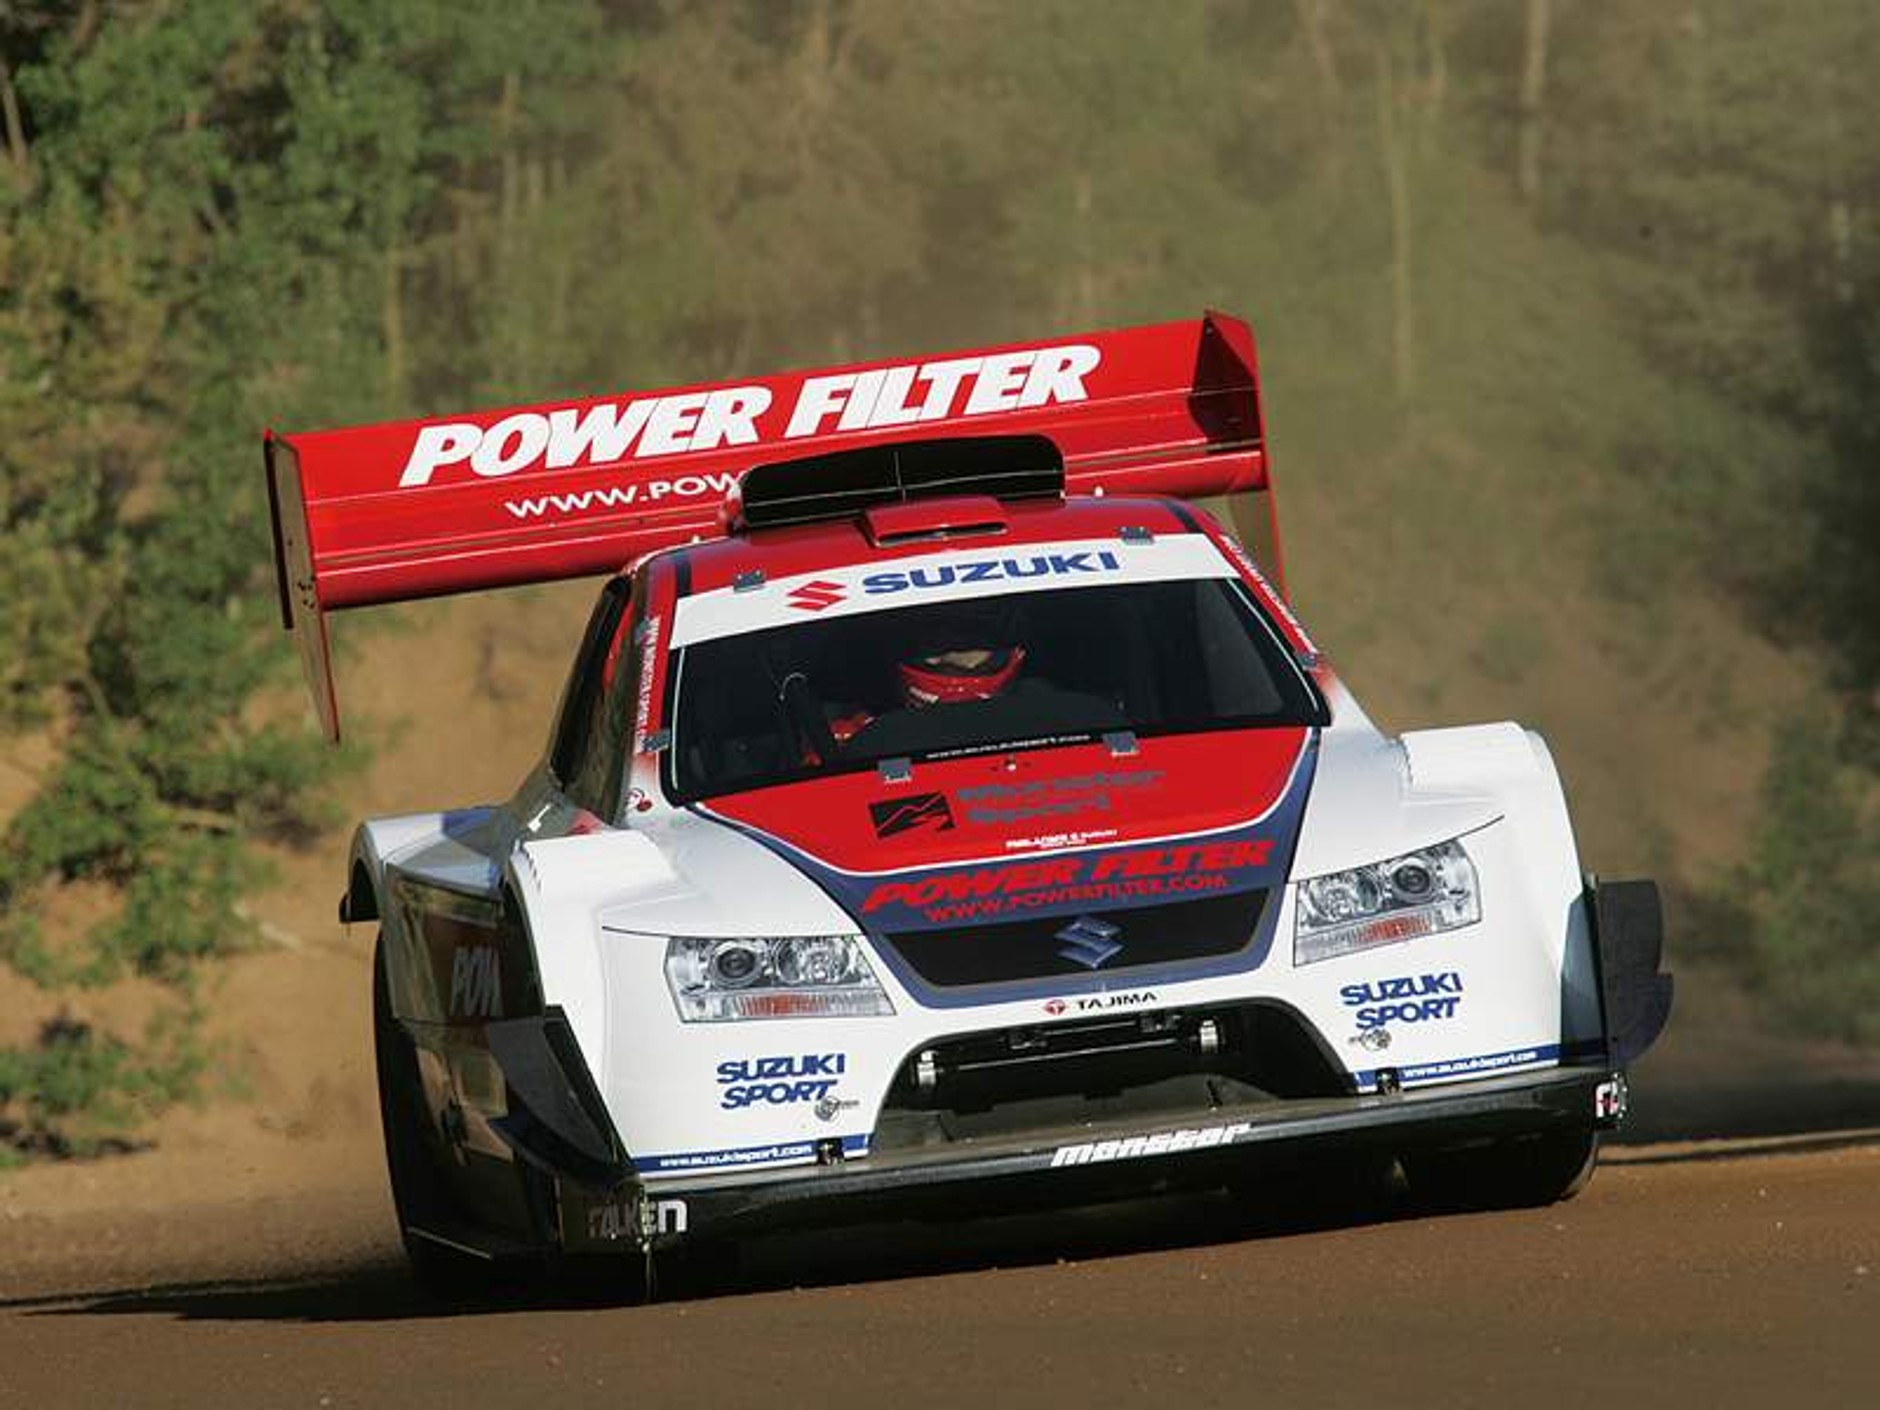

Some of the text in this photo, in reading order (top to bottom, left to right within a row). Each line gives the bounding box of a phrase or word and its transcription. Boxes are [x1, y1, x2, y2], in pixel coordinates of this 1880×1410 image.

[399, 345, 1100, 487] POWER FILTER
[863, 552, 1119, 594] SUZUKI
[864, 857, 1085, 914] POWER
[1092, 839, 1276, 879] FILTER
[1077, 992, 1157, 1011] TAJIMA
[1340, 972, 1463, 1006] SUZUKI
[1356, 997, 1461, 1031] SPORT
[716, 1053, 845, 1084] SUZUKI
[721, 1079, 838, 1110] SPORT
